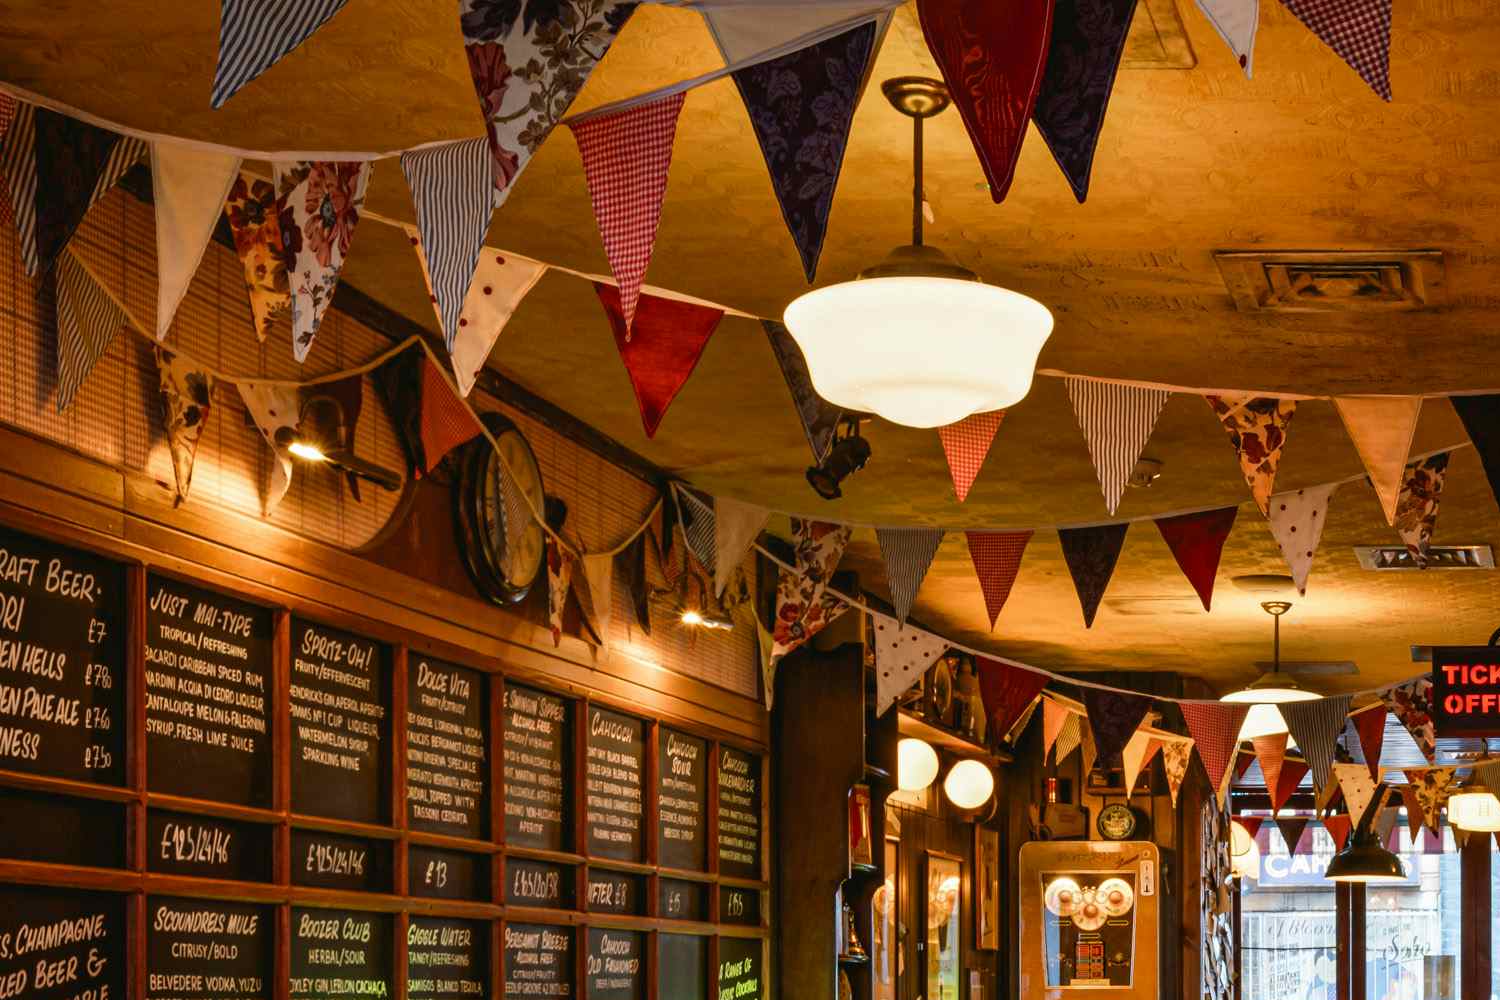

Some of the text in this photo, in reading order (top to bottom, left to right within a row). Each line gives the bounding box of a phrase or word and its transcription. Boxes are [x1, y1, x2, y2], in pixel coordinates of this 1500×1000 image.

[150, 589, 253, 637] JUST MAI-TYPE
[22, 645, 66, 680] HELLS
[417, 662, 471, 700] DOLCE VITA
[21, 686, 80, 727] PALE ALE
[206, 730, 228, 747] LIME
[231, 735, 254, 753] JUICE
[591, 711, 633, 744] CAHOOCH
[672, 756, 692, 777] SOUR
[1264, 853, 1413, 878] CAHS
[154, 906, 259, 935] SCOUNDRELS MULE
[299, 913, 371, 943] BOOZER CLUB
[441, 927, 471, 947] WATER
[34, 948, 107, 989] BEER &
[308, 947, 366, 967] HERBAL/SOUR
[149, 973, 203, 993] BELVEDERE
[238, 976, 262, 993] YUZU
